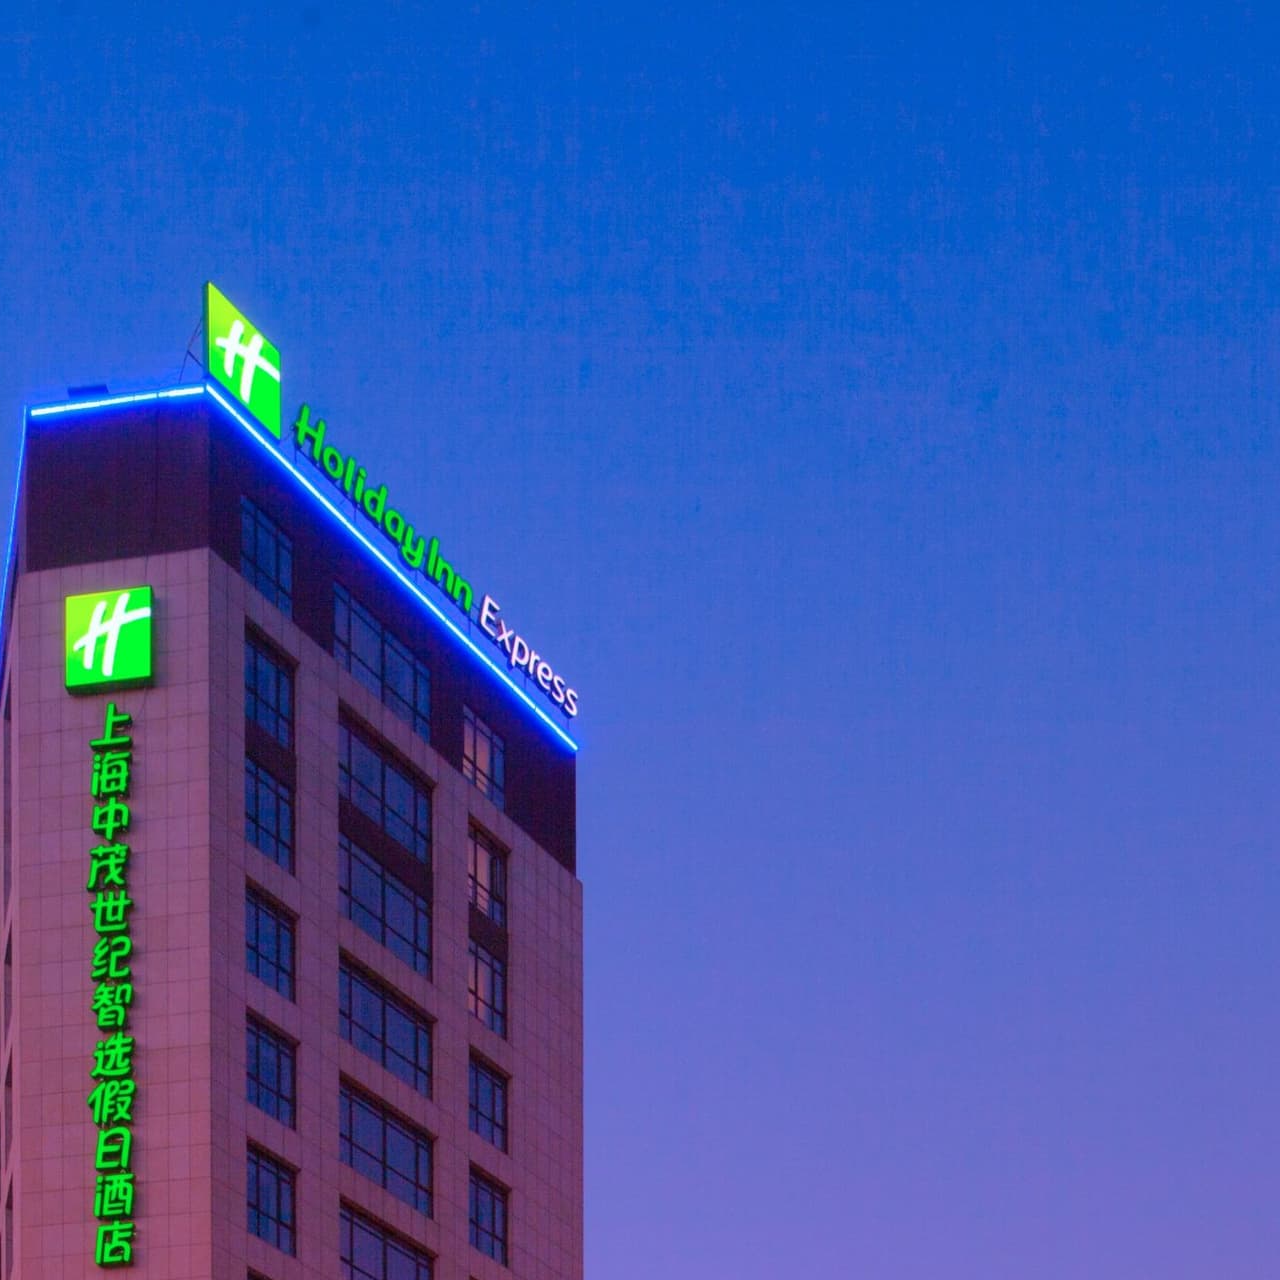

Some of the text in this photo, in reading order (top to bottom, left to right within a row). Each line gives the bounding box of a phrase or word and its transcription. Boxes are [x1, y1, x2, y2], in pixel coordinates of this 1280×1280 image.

[294, 402, 579, 718] Holiday Inn Express
[89, 700, 136, 1267] 上海中茂世纪智选假日酒店
